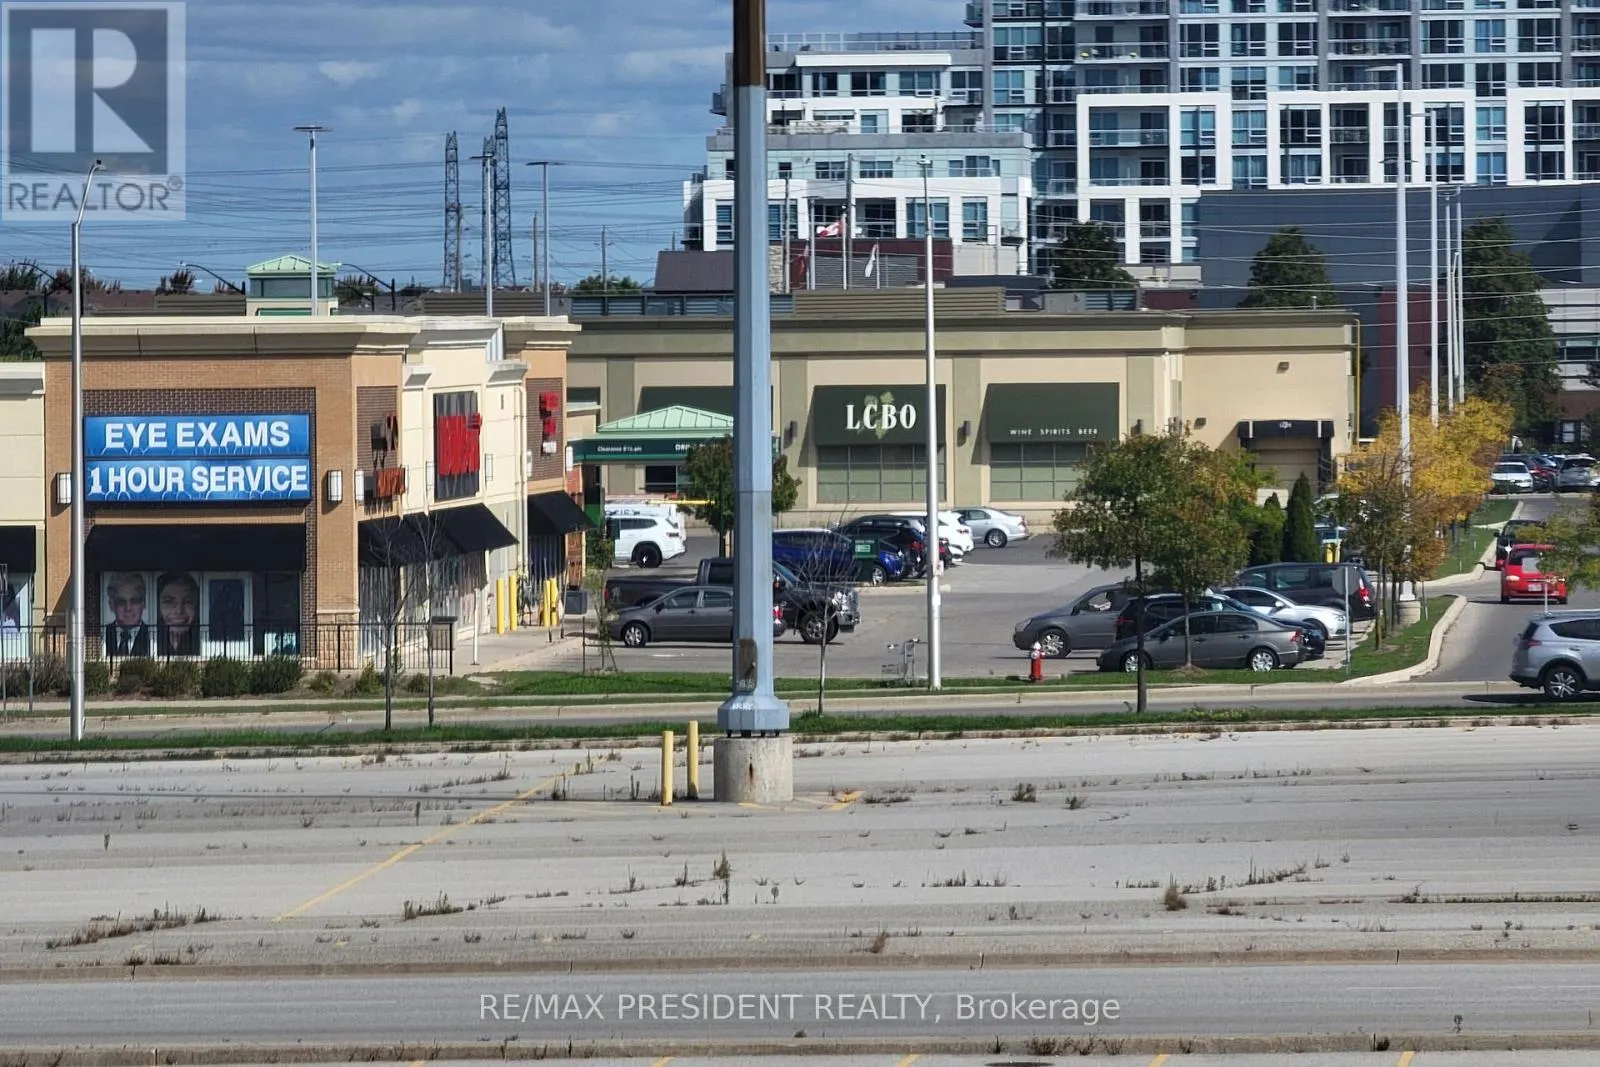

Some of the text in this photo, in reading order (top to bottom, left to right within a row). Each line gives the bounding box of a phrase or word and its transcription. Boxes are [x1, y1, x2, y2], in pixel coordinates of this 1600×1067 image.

[845, 403, 917, 430] LCBO
[105, 421, 290, 448] EYE EXAMS
[1008, 428, 1032, 436] WINE
[1040, 428, 1071, 436] SPIRITS
[90, 465, 308, 493] 1 HOUR SERVICE
